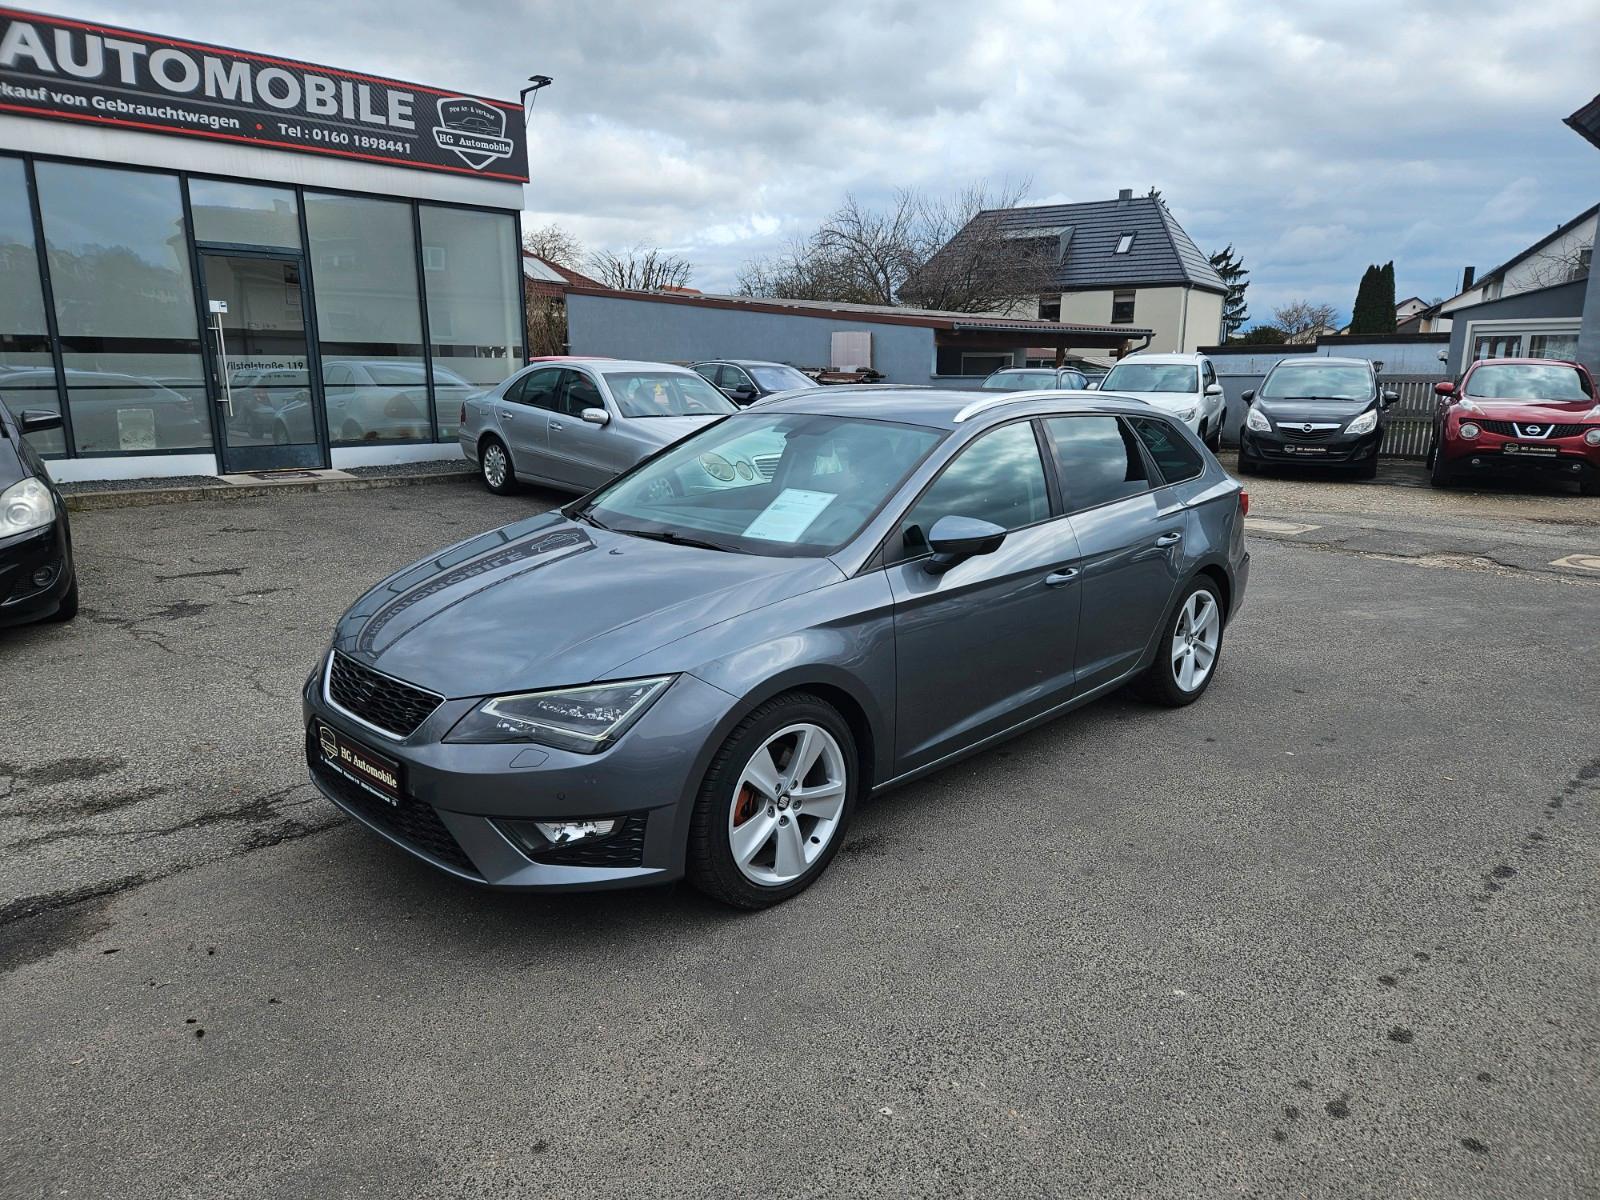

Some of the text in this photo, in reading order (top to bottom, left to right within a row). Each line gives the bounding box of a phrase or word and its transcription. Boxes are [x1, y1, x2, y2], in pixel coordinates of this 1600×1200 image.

[1, 20, 416, 130] AUTOMOBILE
[0, 82, 240, 129] kauf von Gebrauchtwagen
[313, 128, 349, 145] 0160
[353, 134, 411, 154] 1898441
[439, 133, 510, 152] HG Automobile
[287, 361, 304, 371] 119
[340, 746, 351, 762] HG
[353, 755, 397, 788] Automobile
